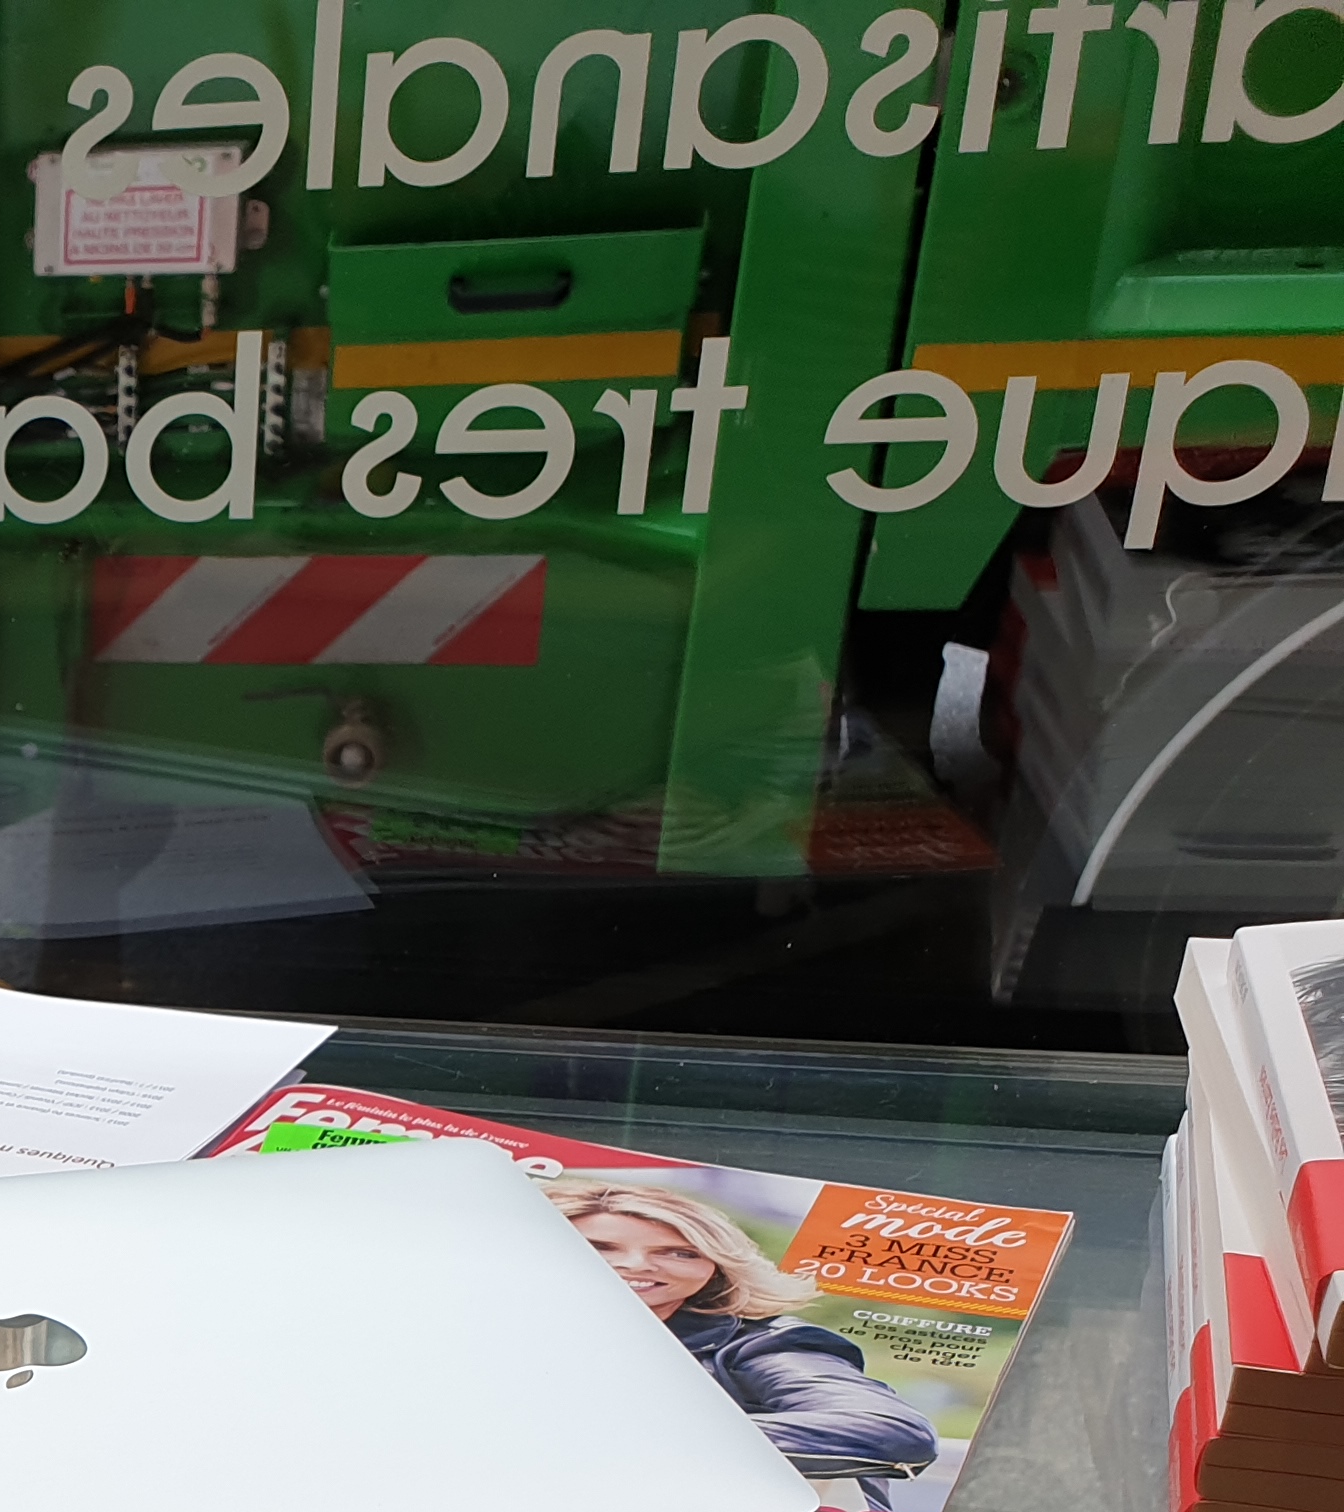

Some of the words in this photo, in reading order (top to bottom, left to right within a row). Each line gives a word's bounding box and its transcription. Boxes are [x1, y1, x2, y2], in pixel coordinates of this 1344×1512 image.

[343, 1099, 397, 1121] féminin
[412, 1113, 443, 1131] plus
[16, 1146, 116, 1171] Quelques
[864, 1193, 986, 1222] Spécial
[840, 1210, 1027, 1248] mode
[811, 1243, 1015, 1285] FRANCE
[844, 1233, 869, 1249] 3
[880, 1238, 999, 1265] MISS
[793, 1259, 847, 1280] 20
[856, 1266, 1020, 1303] LOOKS
[852, 1309, 993, 1338] COIFFURE
[861, 1319, 894, 1332] Les
[904, 1326, 988, 1346] astuces
[838, 1325, 867, 1337] de
[873, 1332, 923, 1348] pros
[932, 1340, 986, 1356] pour
[889, 1342, 982, 1365] changer
[893, 1352, 922, 1365] de
[930, 1354, 978, 1370] tête
